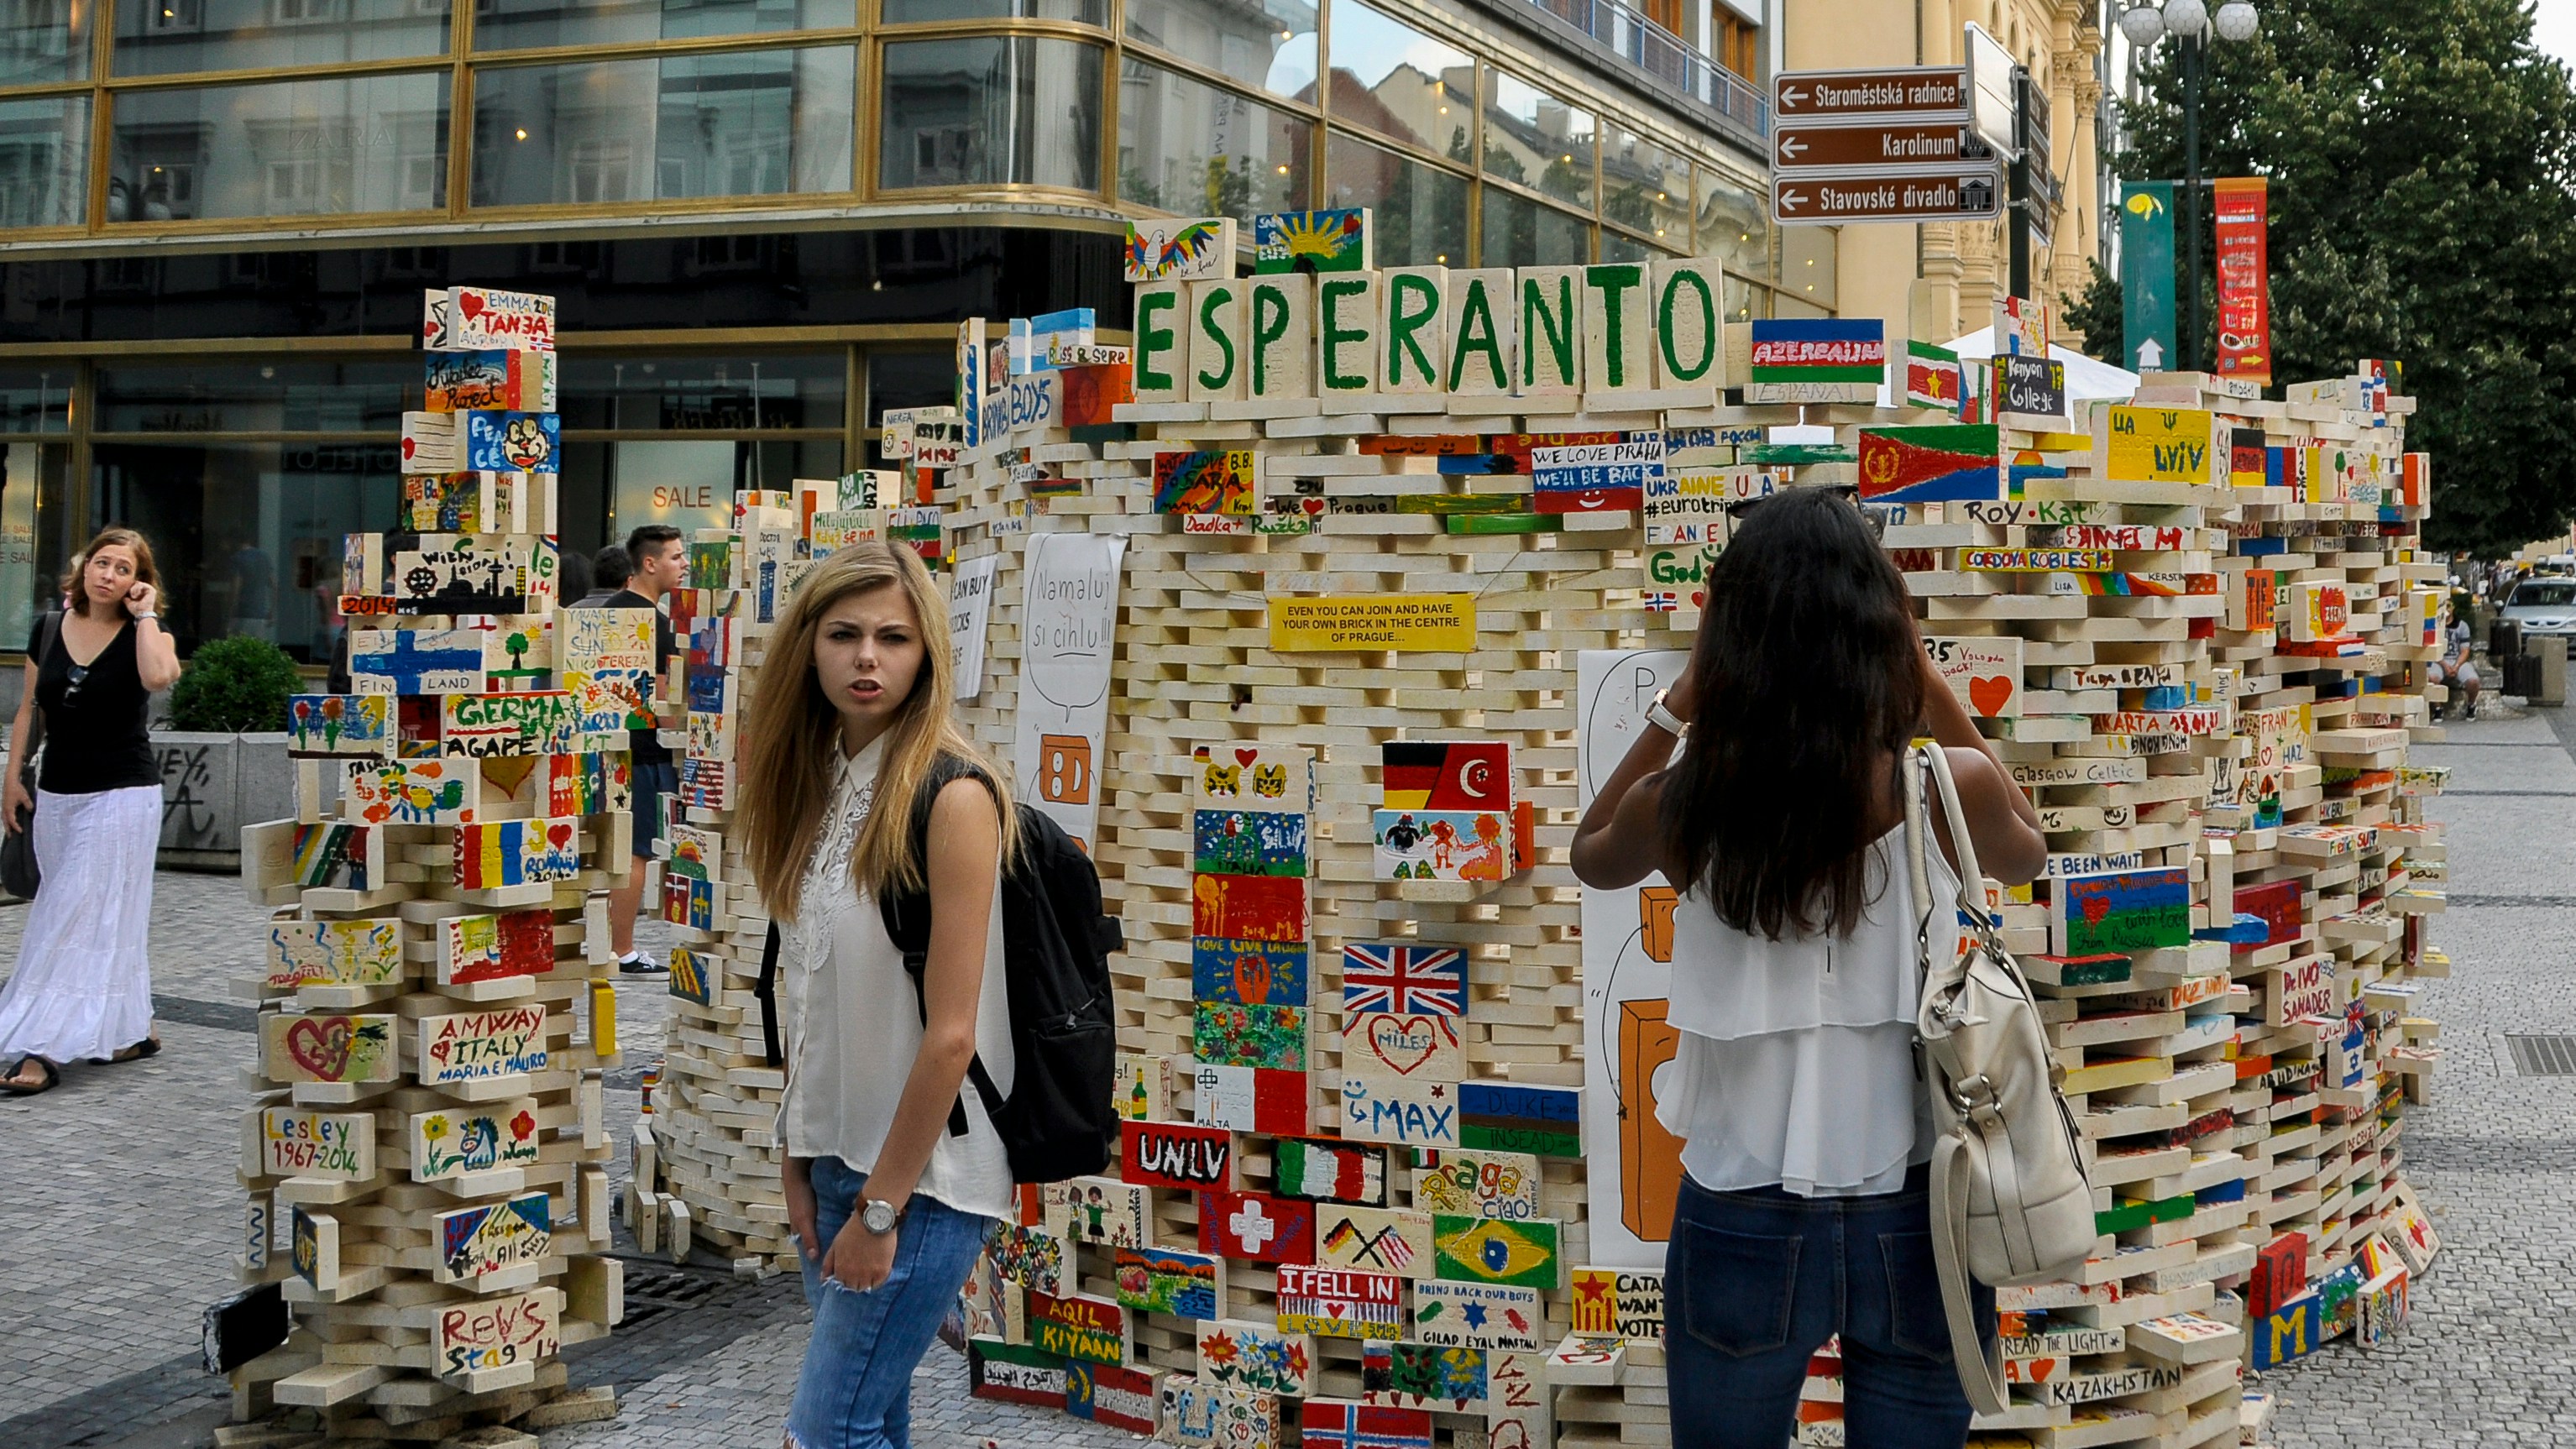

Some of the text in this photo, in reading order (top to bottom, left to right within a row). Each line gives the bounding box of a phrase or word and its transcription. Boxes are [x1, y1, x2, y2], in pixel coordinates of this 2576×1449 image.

[1815, 82, 1956, 107] Staroměstská radnice
[1882, 133, 1956, 156] Karolinum
[1820, 184, 1956, 211] Stavovské divadlo
[1137, 265, 1715, 396] ESPERANTO
[2008, 356, 2044, 383] Kenyon
[1011, 378, 1050, 425] BOYS
[2009, 383, 2054, 412] College
[1533, 442, 1662, 464] WE LOVE PRAHA
[1581, 468, 1601, 484] BE
[1647, 474, 1775, 498] UKRAINE USA
[652, 485, 711, 508] SALE
[1327, 497, 1388, 514] Prague
[1647, 523, 1719, 544] FRANCE
[969, 574, 990, 596] BUY
[1036, 568, 1110, 610] Namaluj
[2054, 581, 2074, 592] LISA
[1288, 603, 1453, 616] EVEN YOU CAN JOIN AND HAVE
[1282, 617, 1459, 630] YOUR OWN BRICK IN THE CENTRE
[1331, 631, 1405, 642] OF PRAGUE...
[359, 677, 470, 693] FIN LAND
[2261, 711, 2287, 734] FRAN
[2087, 764, 2135, 781] Celtic
[2062, 855, 2102, 875] BEEN
[2108, 852, 2142, 868] WAIT
[437, 1007, 544, 1039] AMWAY
[453, 1031, 528, 1065] ITALY
[437, 1059, 493, 1081] MARIA
[504, 1051, 547, 1073] MAURO
[1489, 1091, 1555, 1120] DUKE
[266, 1113, 351, 1143] Lesley
[1197, 1117, 1230, 1129] MALTA
[1372, 1099, 1453, 1142] MAX
[1490, 1128, 1555, 1153] INSEAD
[1140, 1133, 1225, 1180] UNLV
[1280, 1269, 1394, 1300] I FELL IN
[1453, 1286, 1482, 1298] BACK
[1484, 1288, 1507, 1300] OUR
[1509, 1289, 1535, 1303] BOYS
[1615, 1274, 1665, 1294] CATA
[1050, 1300, 1102, 1327] AQIL
[1286, 1316, 1364, 1338] LOVE
[1043, 1325, 1121, 1362] KIYAAN
[1422, 1331, 1460, 1345] GILAD
[1465, 1334, 1493, 1349] EYAL
[2069, 1331, 2108, 1352] LIGHT
[2053, 1366, 2182, 1406] KAZAKHSTAN
